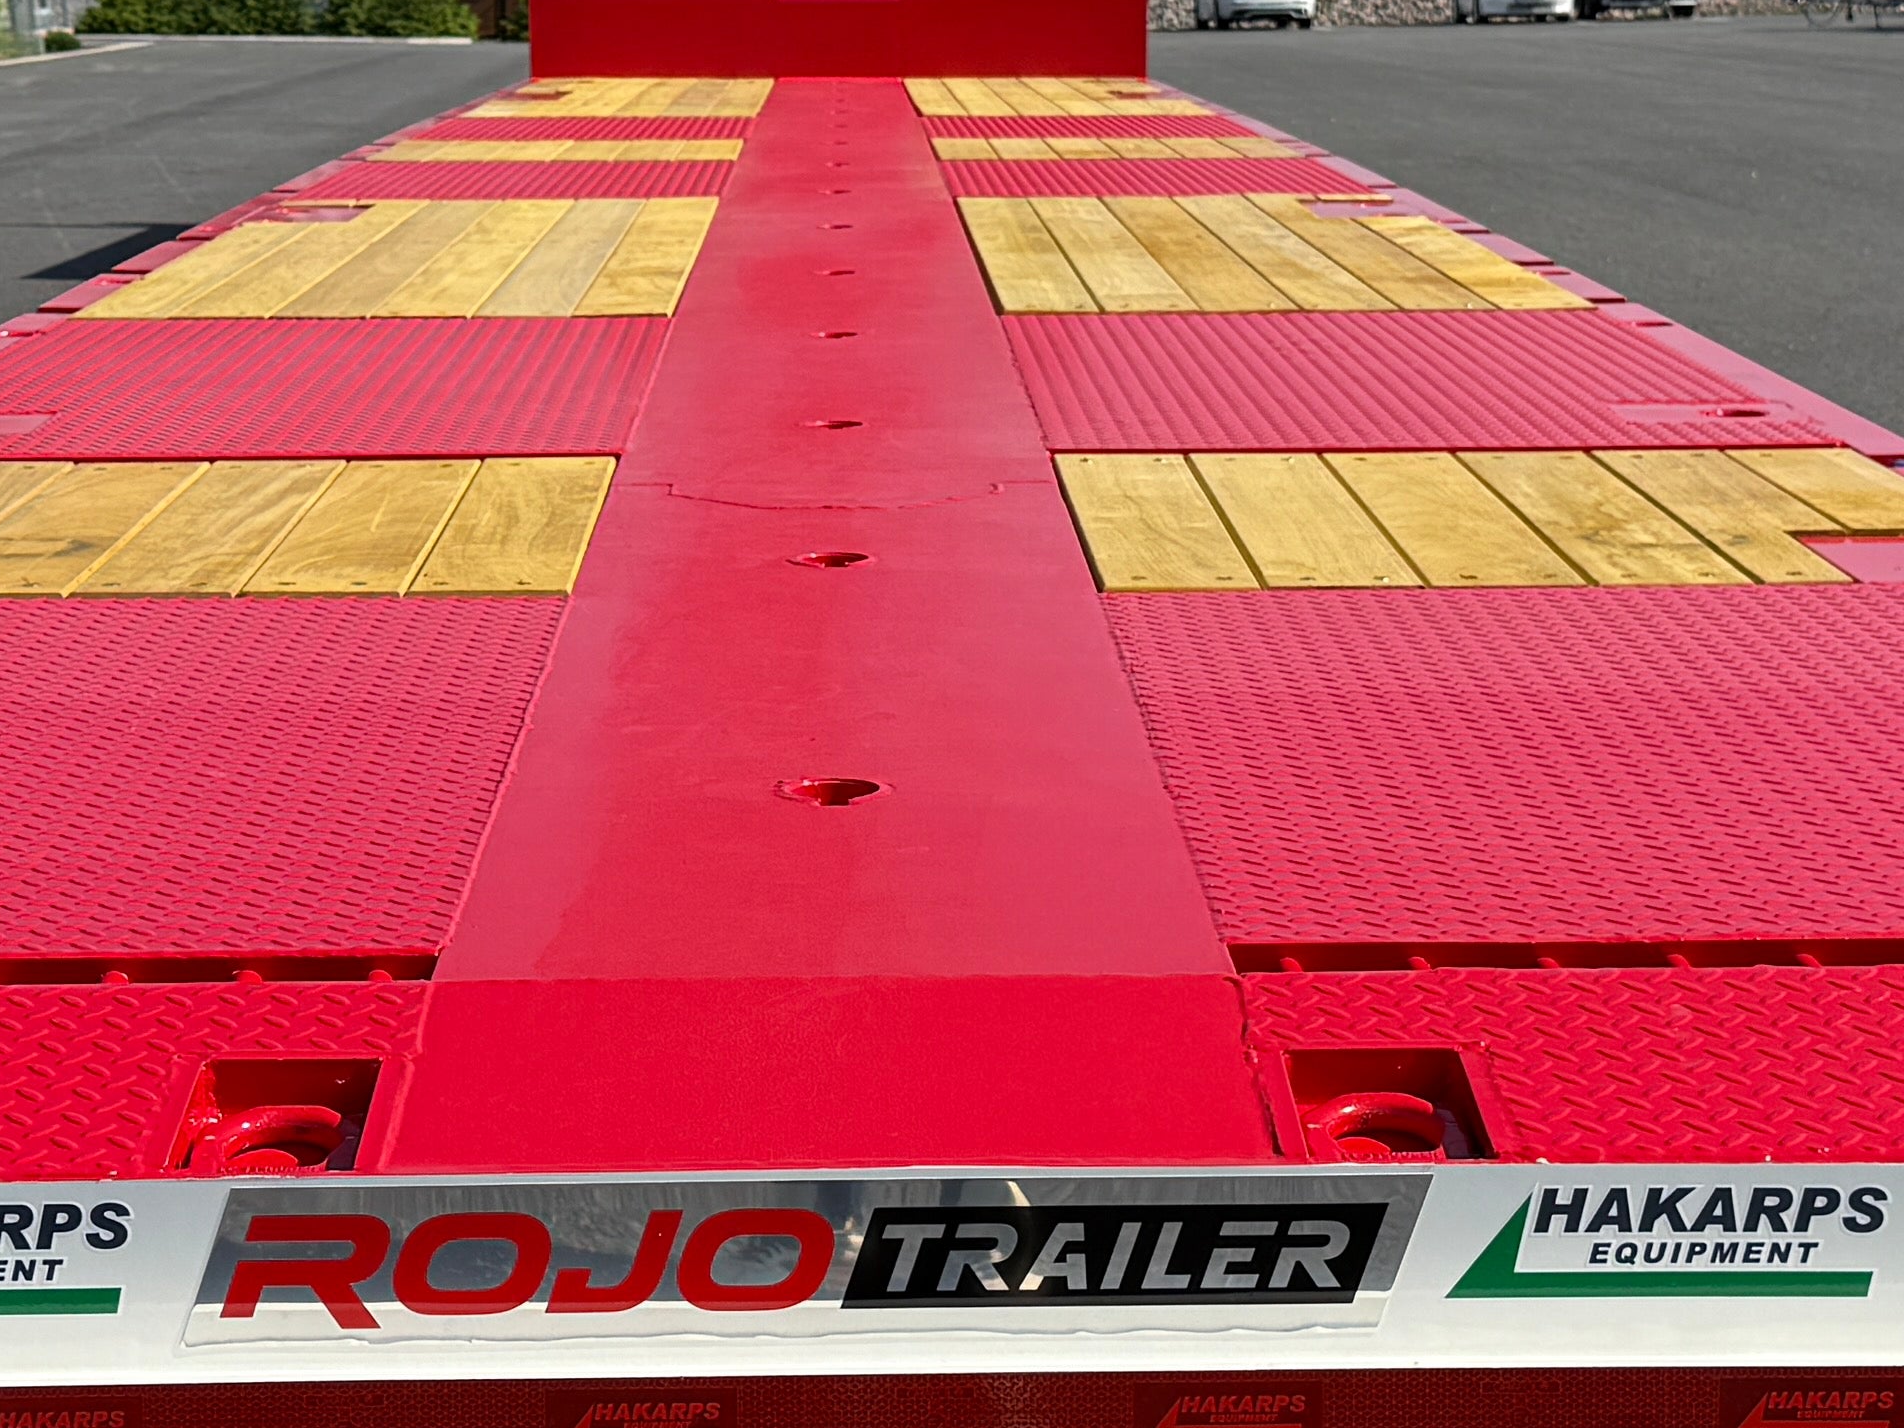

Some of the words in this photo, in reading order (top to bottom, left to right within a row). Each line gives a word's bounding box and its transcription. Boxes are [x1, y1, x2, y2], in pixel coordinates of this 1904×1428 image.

[1534, 1185, 1891, 1236] HAKARPS
[1587, 1239, 1820, 1265] EQUIPMENT
[218, 1208, 836, 1329] ROJO
[881, 1218, 1350, 1292] TRAILER
[1181, 1395, 1306, 1413] HAKARPS
[1768, 1391, 1895, 1409] HAKARPS
[595, 1403, 721, 1420] HAKARPS
